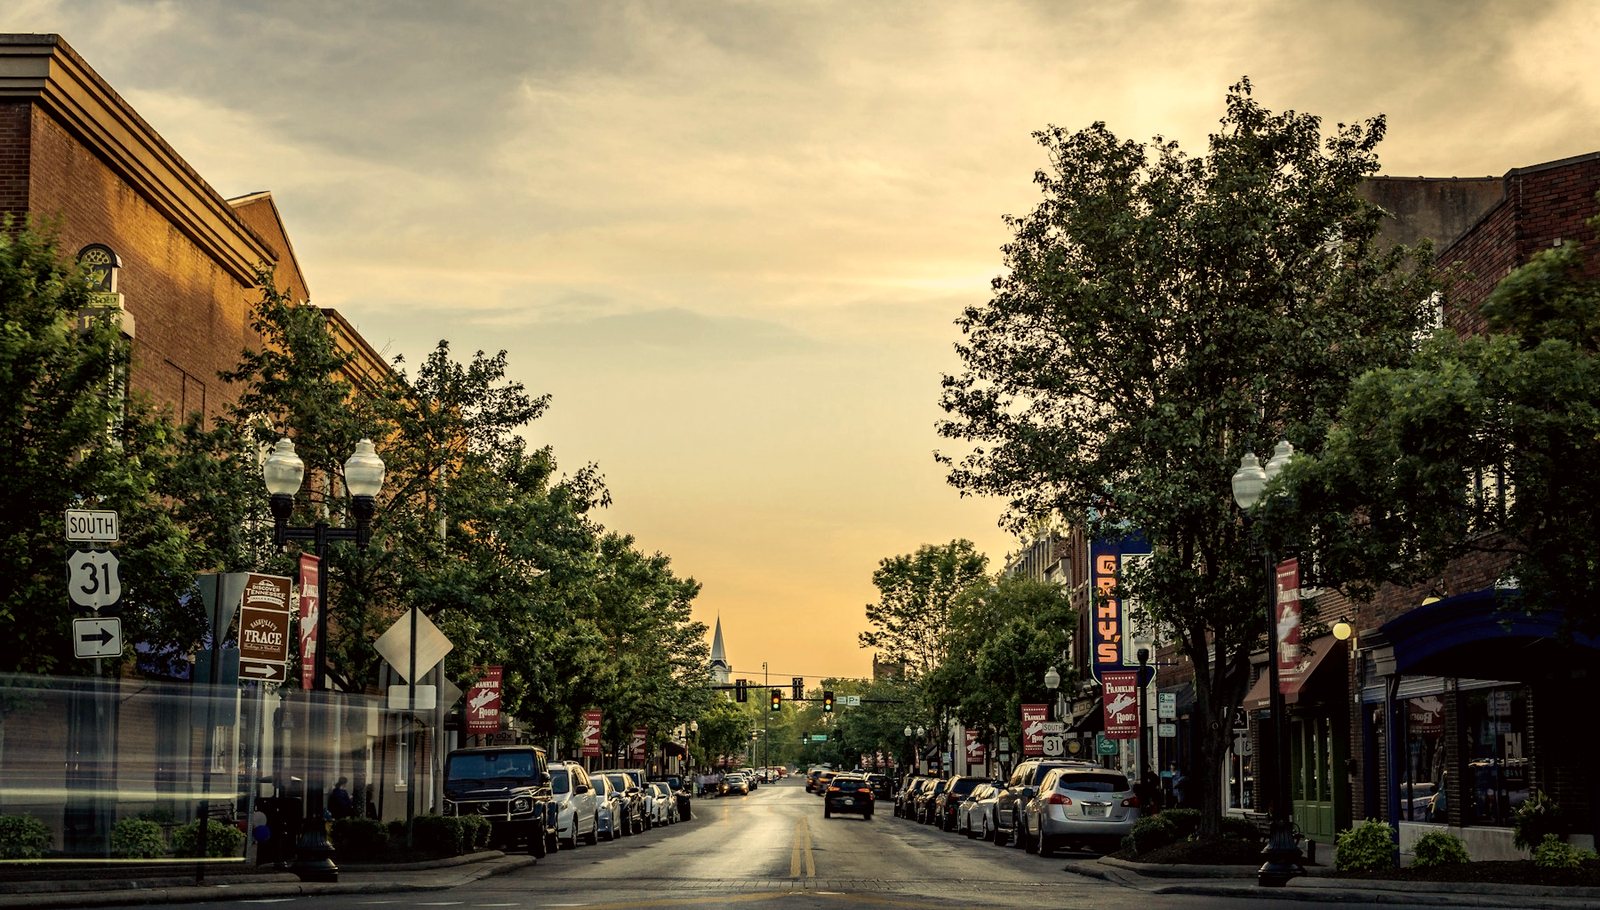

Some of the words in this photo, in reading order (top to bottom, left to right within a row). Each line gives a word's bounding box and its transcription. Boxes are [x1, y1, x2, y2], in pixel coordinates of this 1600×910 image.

[70, 517, 114, 534] SOUTH
[80, 562, 110, 595] 31
[246, 588, 286, 600] TENNESSEE
[252, 584, 280, 592] DISCOVER
[244, 629, 282, 645] TRACE
[1105, 682, 1135, 694] FRANKLIN
[478, 707, 498, 719] RODEO
[1116, 712, 1135, 724] RODEO
[1046, 739, 1059, 751] 31
